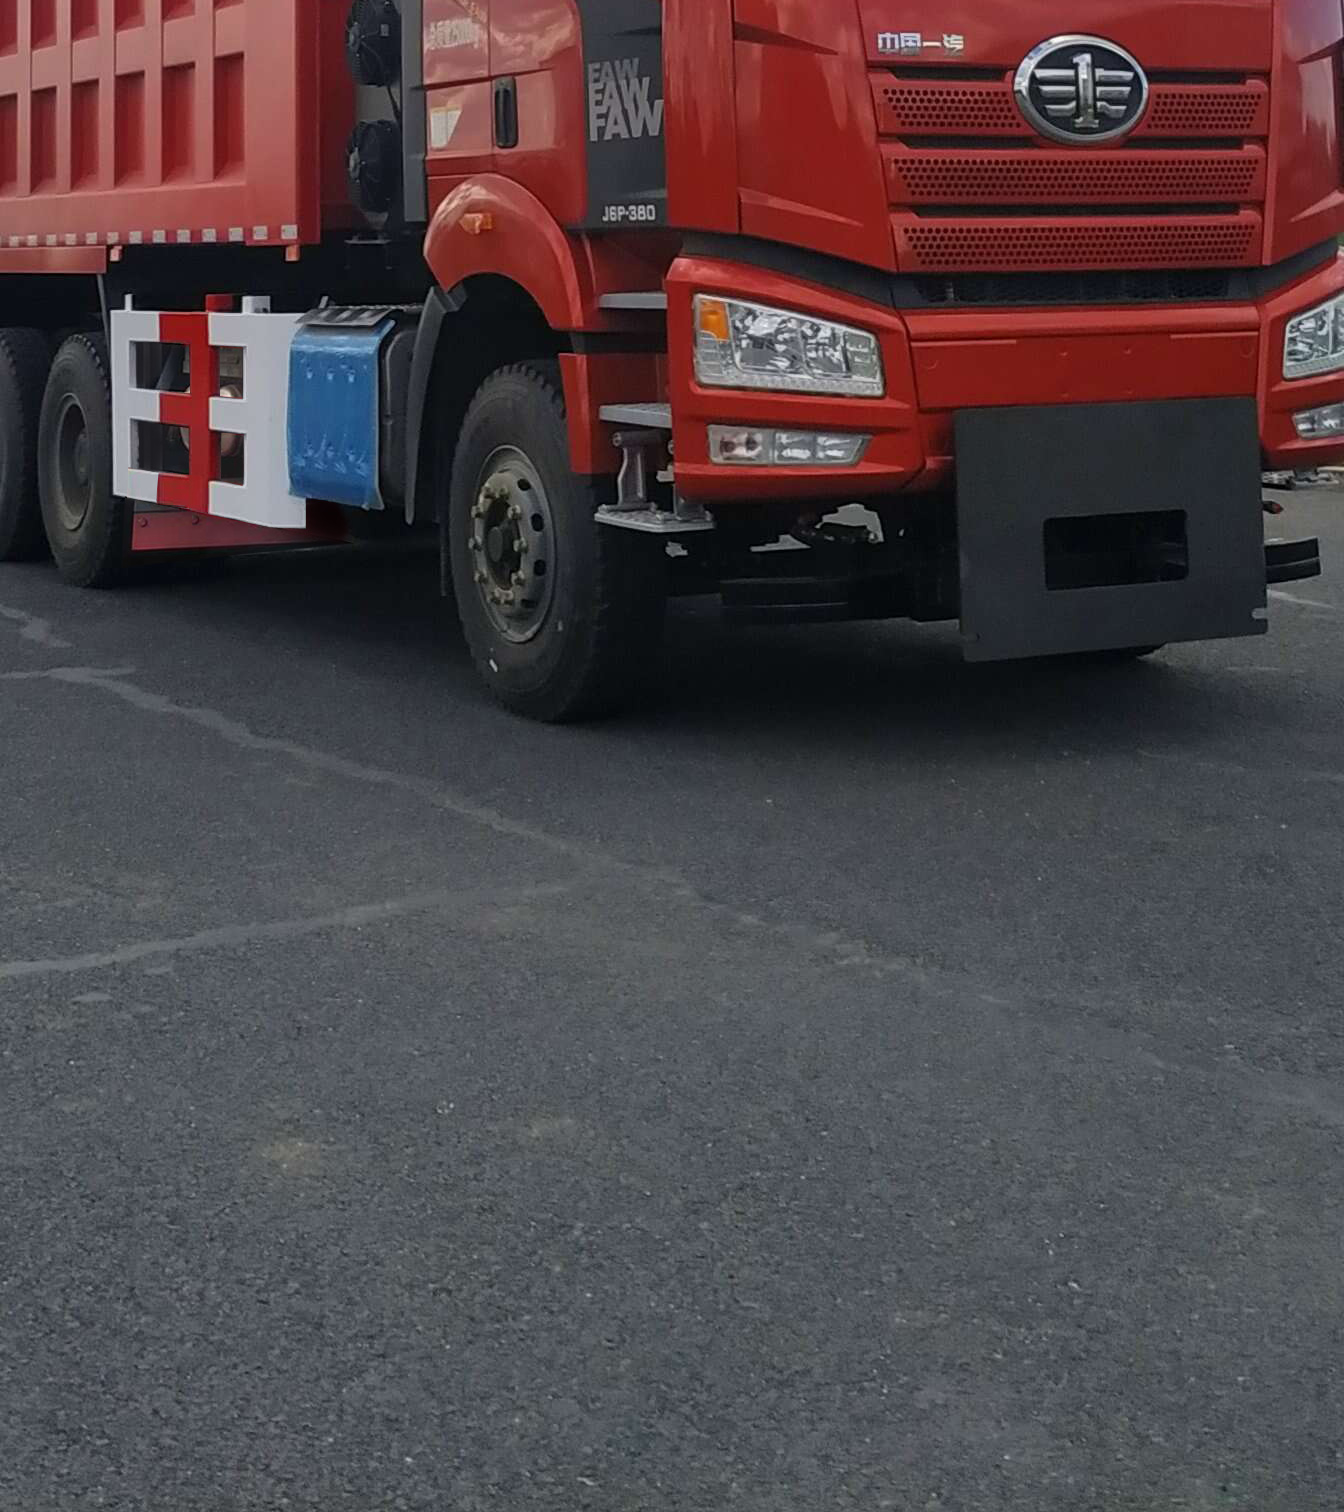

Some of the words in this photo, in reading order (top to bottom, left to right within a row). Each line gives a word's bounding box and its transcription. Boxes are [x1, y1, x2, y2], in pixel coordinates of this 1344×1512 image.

[877, 31, 964, 56] 中国一汽
[588, 56, 640, 83] FAW
[588, 76, 651, 108] FAW
[589, 98, 665, 142] FAW
